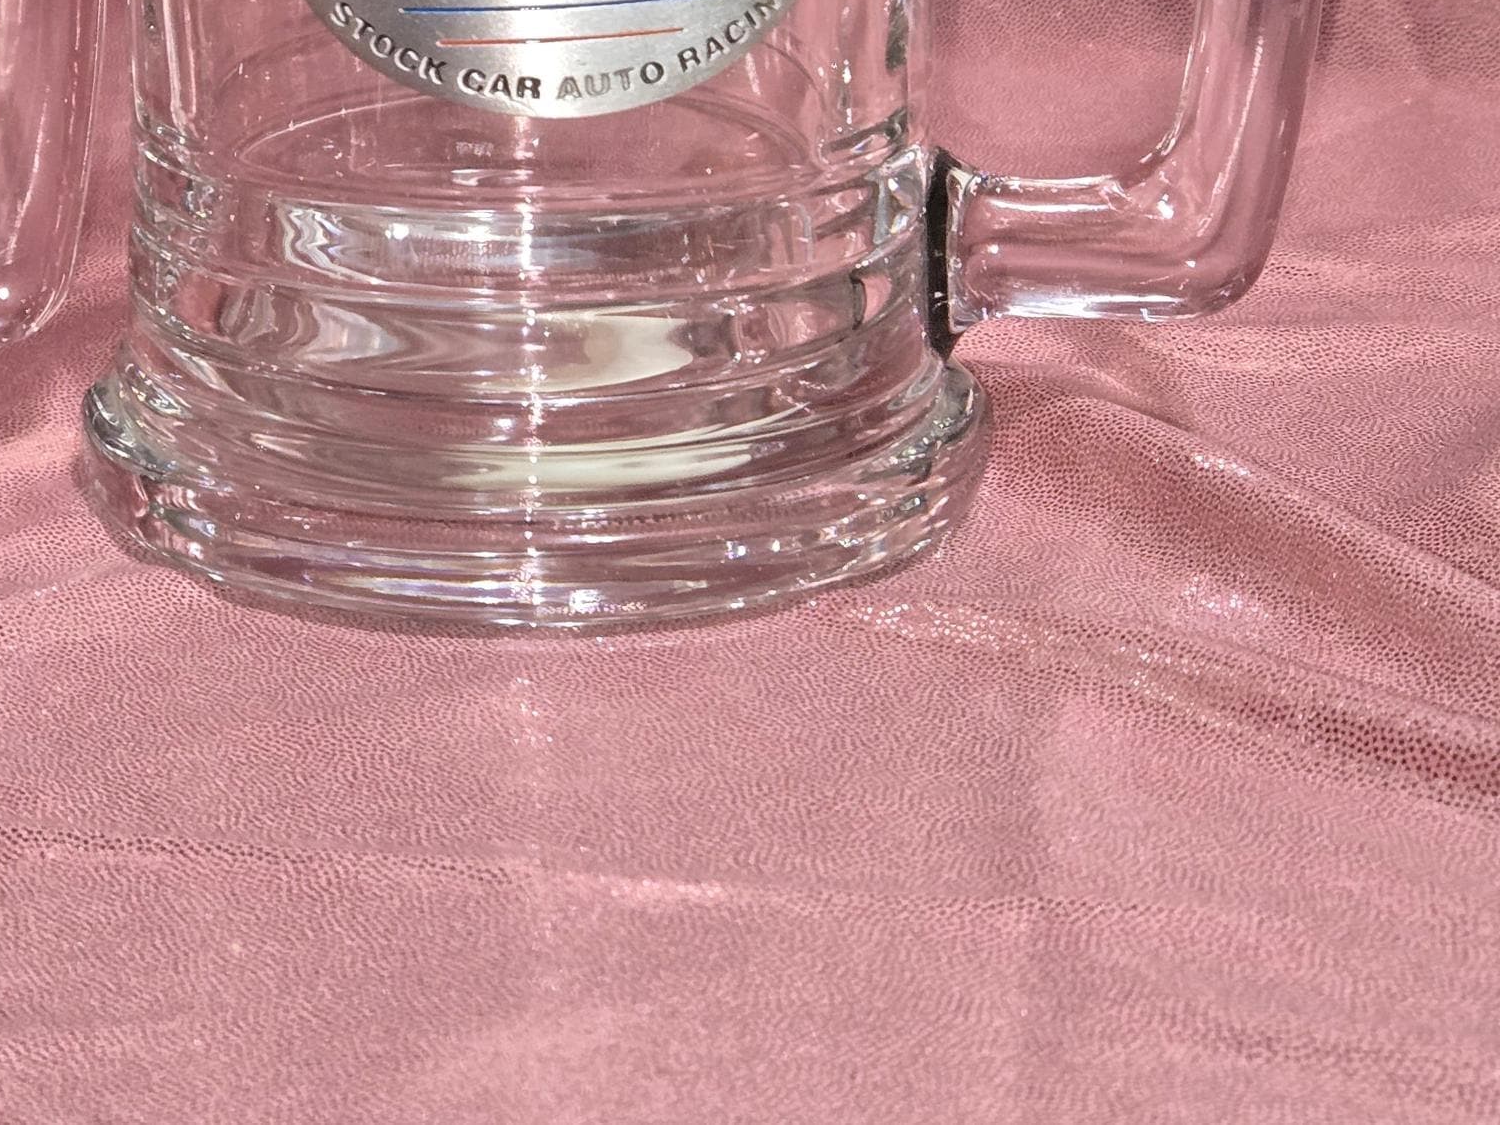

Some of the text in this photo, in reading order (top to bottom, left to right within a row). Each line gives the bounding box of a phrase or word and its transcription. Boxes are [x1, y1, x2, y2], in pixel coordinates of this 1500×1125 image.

[328, 1, 447, 86] STOCK
[456, 68, 543, 102] CAR
[555, 61, 665, 101] AUTO
